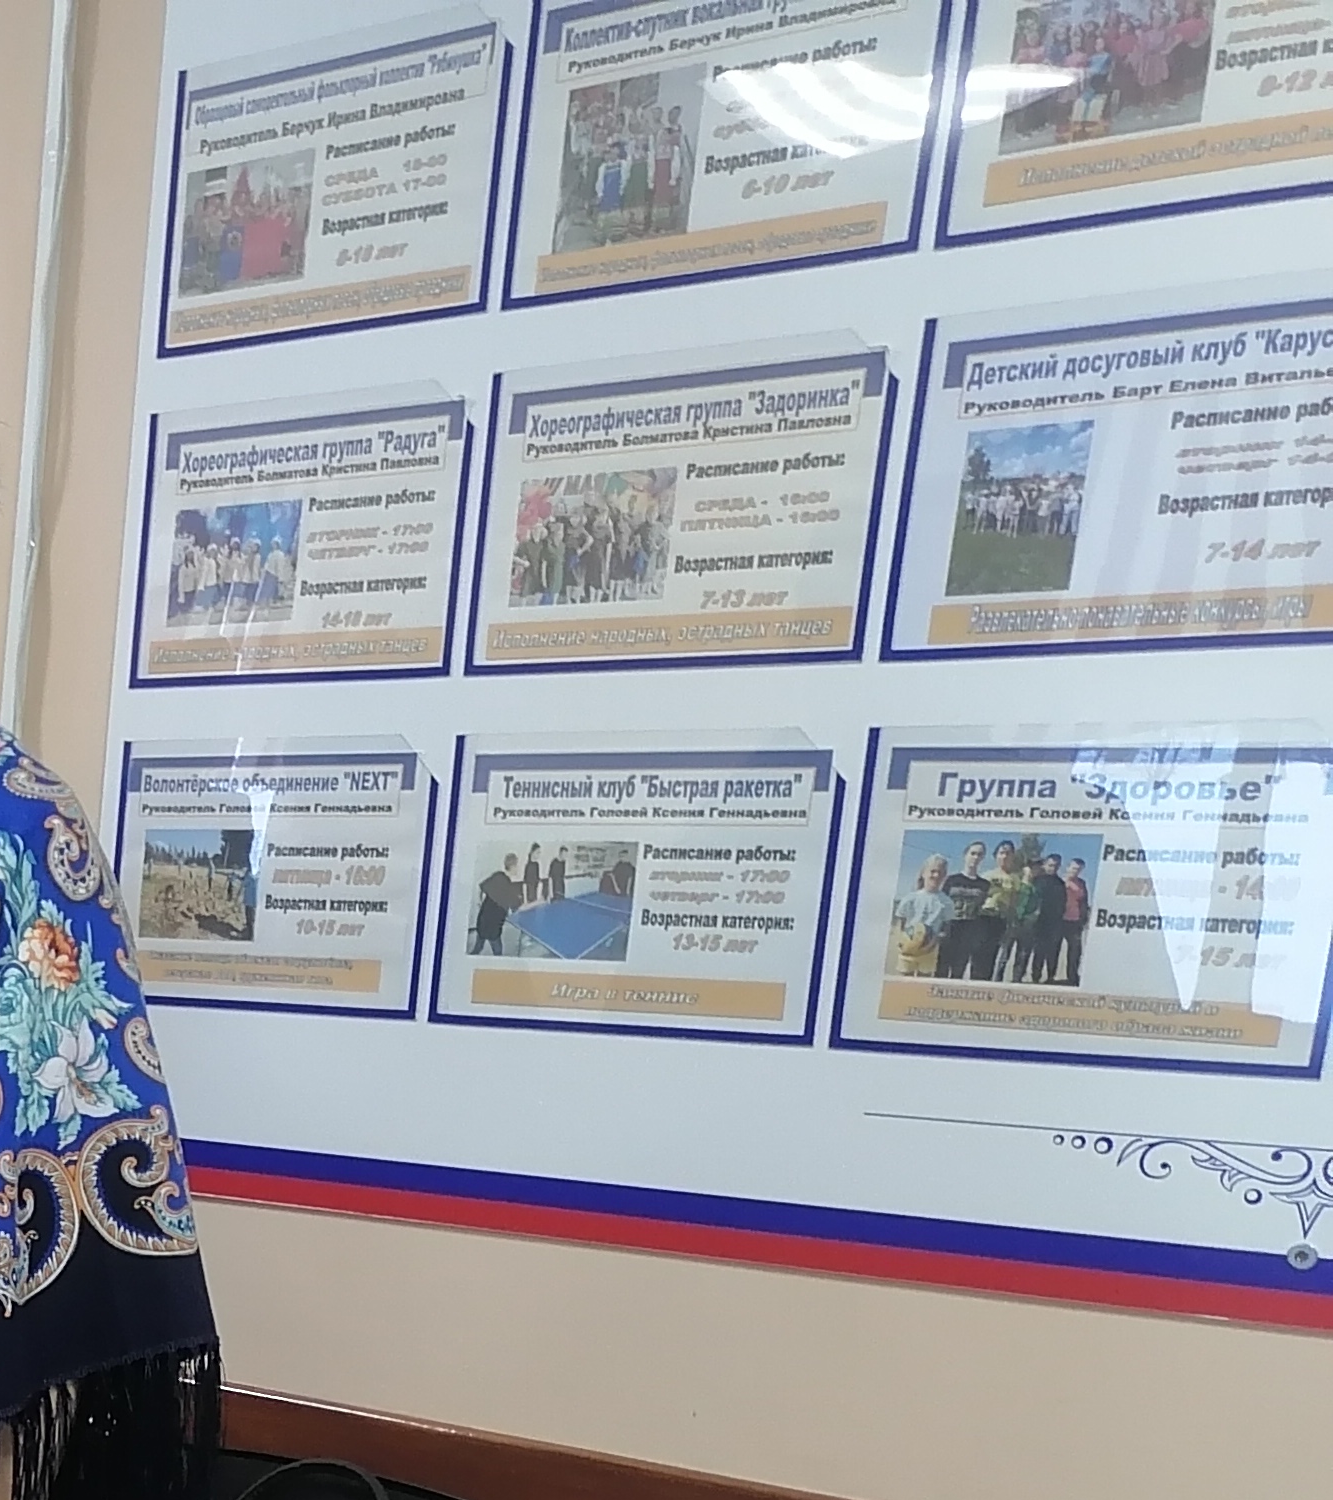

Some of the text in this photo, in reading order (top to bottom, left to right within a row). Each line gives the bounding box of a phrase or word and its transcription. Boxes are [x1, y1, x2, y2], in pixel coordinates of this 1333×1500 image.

[568, 43, 665, 74] Руководитель
[725, 20, 773, 42] Ирина
[1215, 38, 1318, 71] Возрастная
[199, 126, 278, 156] Руководитель
[369, 88, 466, 121] Владимировна
[325, 123, 456, 161] Расписание работы:
[703, 148, 789, 177] Возрастная
[321, 207, 387, 236] Возрастная
[967, 353, 1059, 393] Детский
[1062, 340, 1184, 380] досуговый
[1190, 331, 1247, 367] клуб
[529, 379, 861, 439] Хореографическая группа "Задоринка"
[963, 389, 1105, 416] Руководитель
[1110, 382, 1164, 401] Барт
[1168, 374, 1238, 394] Елена
[1170, 405, 1290, 431] Расписание
[525, 412, 852, 459] Руководитель Болматова Кристина Павловна
[181, 424, 446, 477] Хореографическая группа "Радуга"
[685, 450, 846, 480] Расписание работы:
[179, 475, 255, 494] Руководитель
[321, 461, 377, 479] Кристина
[380, 453, 440, 470] Павловна
[308, 488, 436, 513] Расписание работы:
[1157, 487, 1260, 518] Возрастная
[674, 547, 834, 576] Возрастная категория:
[299, 574, 427, 602] Возрастная категория:
[143, 771, 399, 798] Волонтёрское объединение "NEXT"
[503, 773, 803, 805] Теннисный клуб "Быстрая ракетка"
[937, 771, 1059, 802] Группа
[142, 804, 216, 816] Руководитель
[493, 805, 808, 822] Руководитель Головей Ксения Геннадьевна
[907, 804, 1025, 823] Руководитель
[1029, 806, 1105, 821] Головей
[266, 842, 390, 861] Расписание работы:
[643, 843, 797, 865] Расписание работы:
[264, 895, 388, 916] Возрастная категория:
[641, 908, 795, 934] Возрастная категория:
[1094, 907, 1195, 934] Возрастная
[550, 982, 601, 1002] Игра
